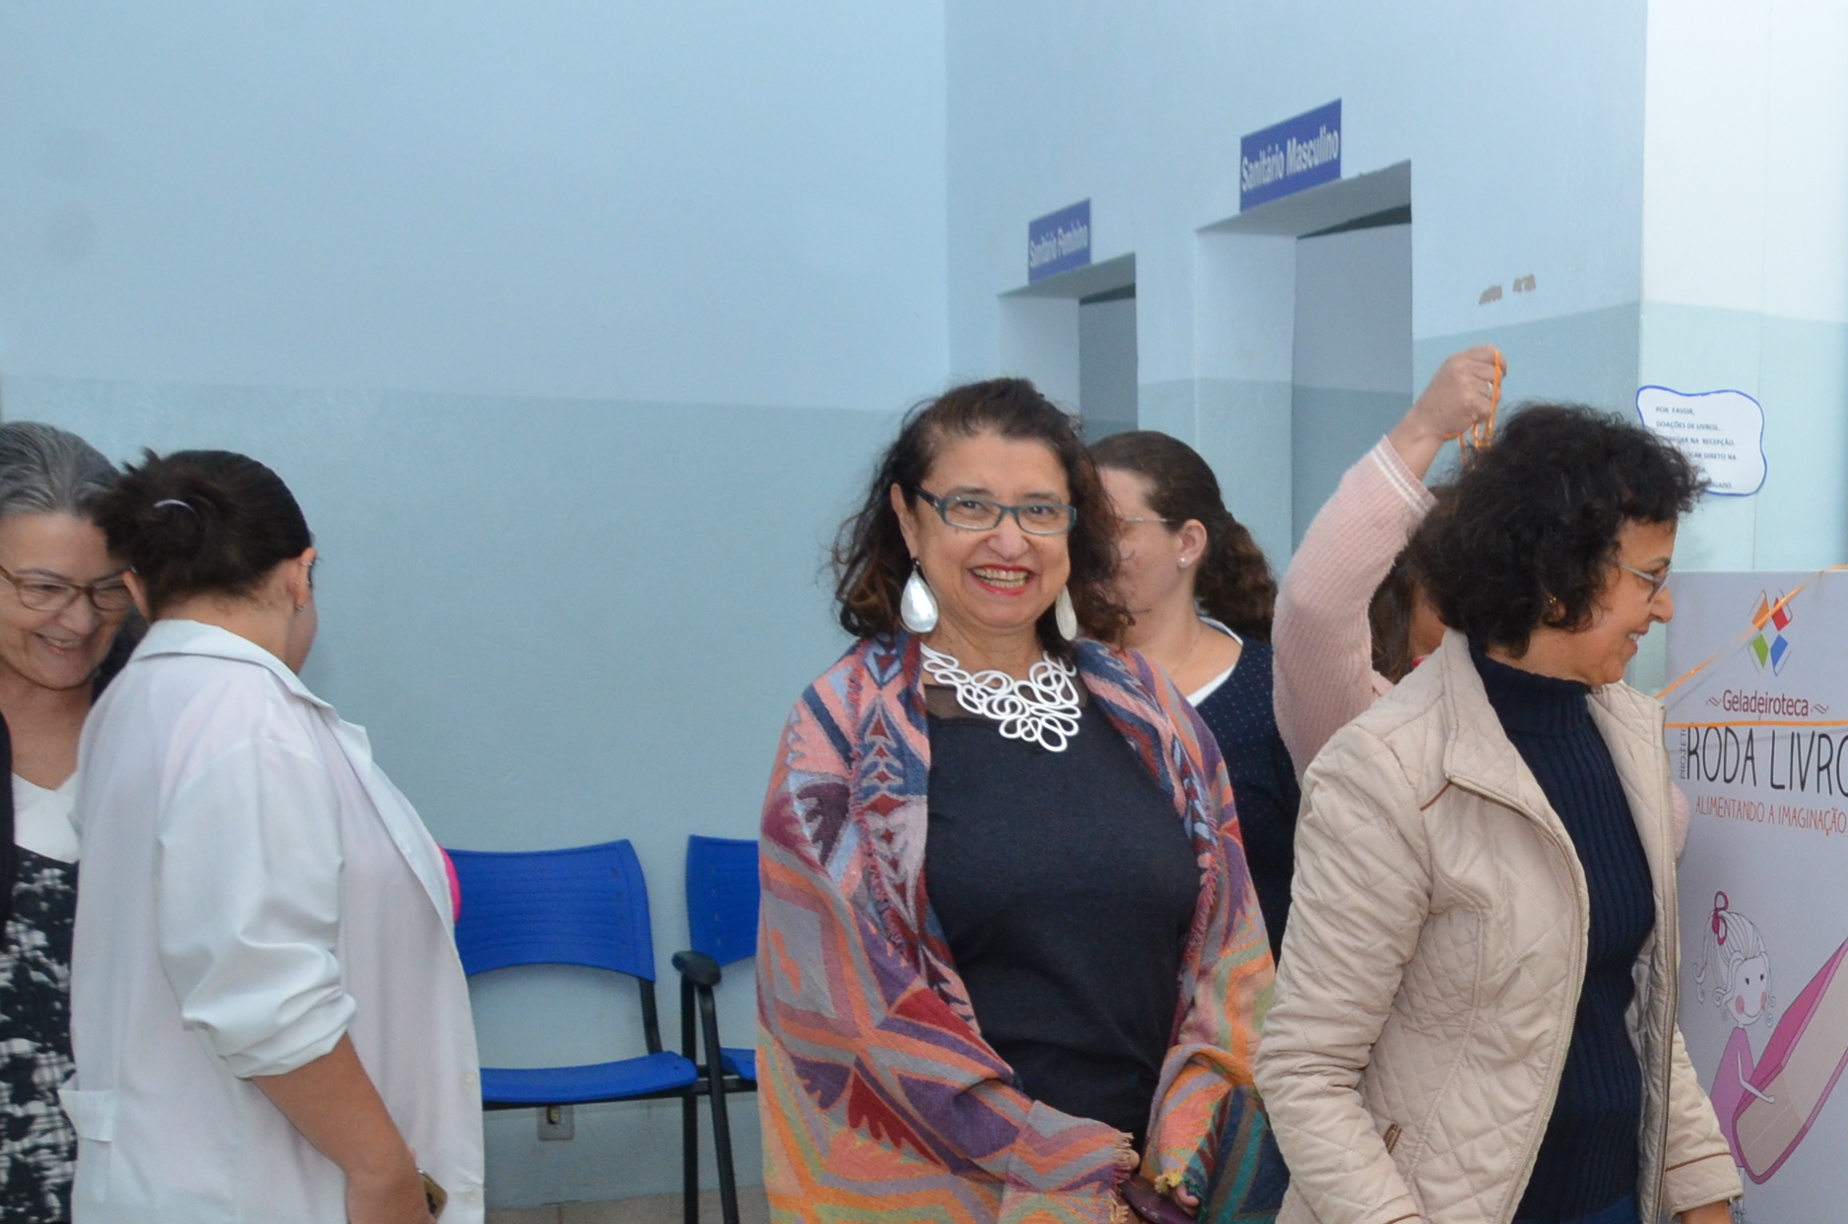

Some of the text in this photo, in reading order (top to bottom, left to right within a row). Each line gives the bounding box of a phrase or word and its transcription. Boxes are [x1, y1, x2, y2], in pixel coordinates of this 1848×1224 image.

[1241, 124, 1339, 192] Sanitário Masculino
[1722, 689, 1809, 717] Geladeiroteca
[1687, 725, 1757, 788] RODA
[1695, 795, 1848, 836] ALIMENTANDO A IMAGINAÇÃO
